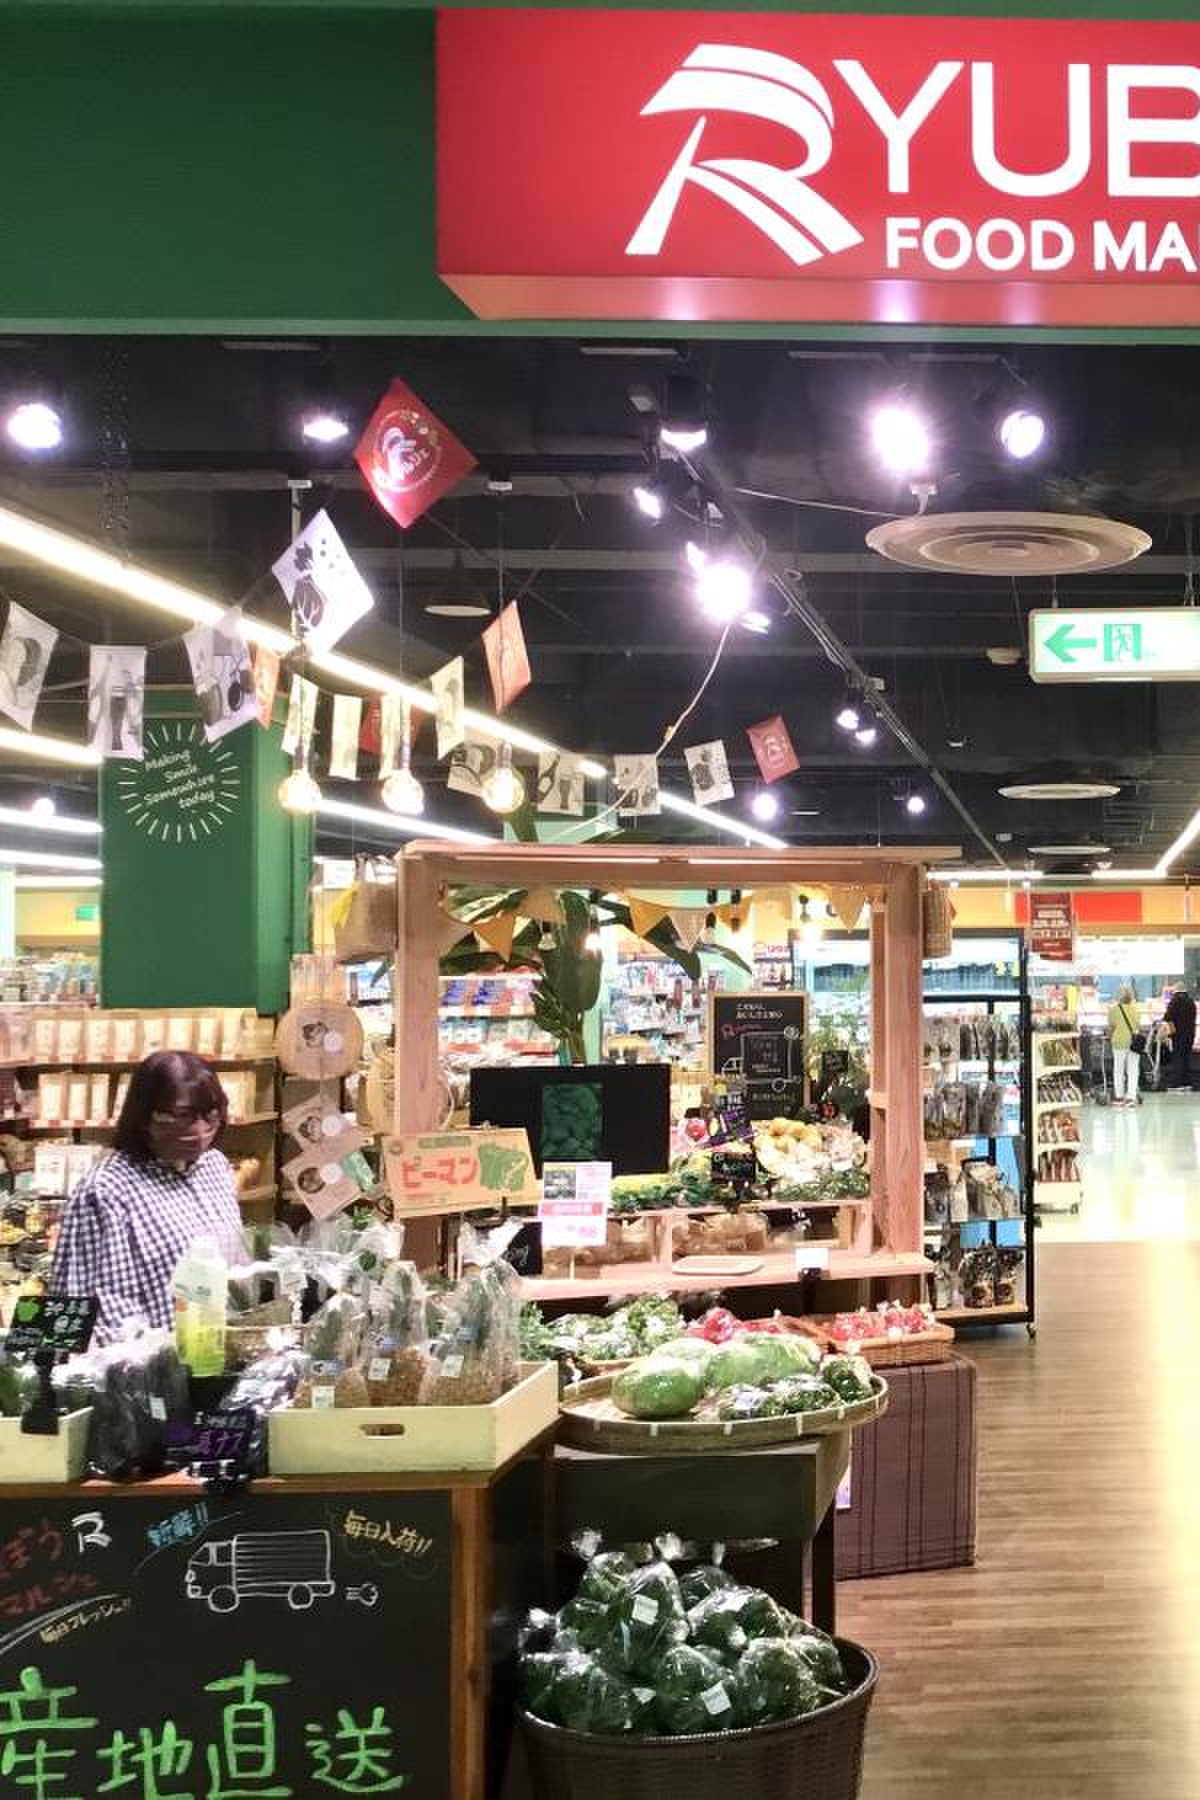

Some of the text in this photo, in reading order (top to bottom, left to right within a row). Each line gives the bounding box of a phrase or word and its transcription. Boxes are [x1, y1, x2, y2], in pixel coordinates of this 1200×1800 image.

[885, 217, 1075, 272] FOOD
[0, 1659, 407, 1800] 産地直送
